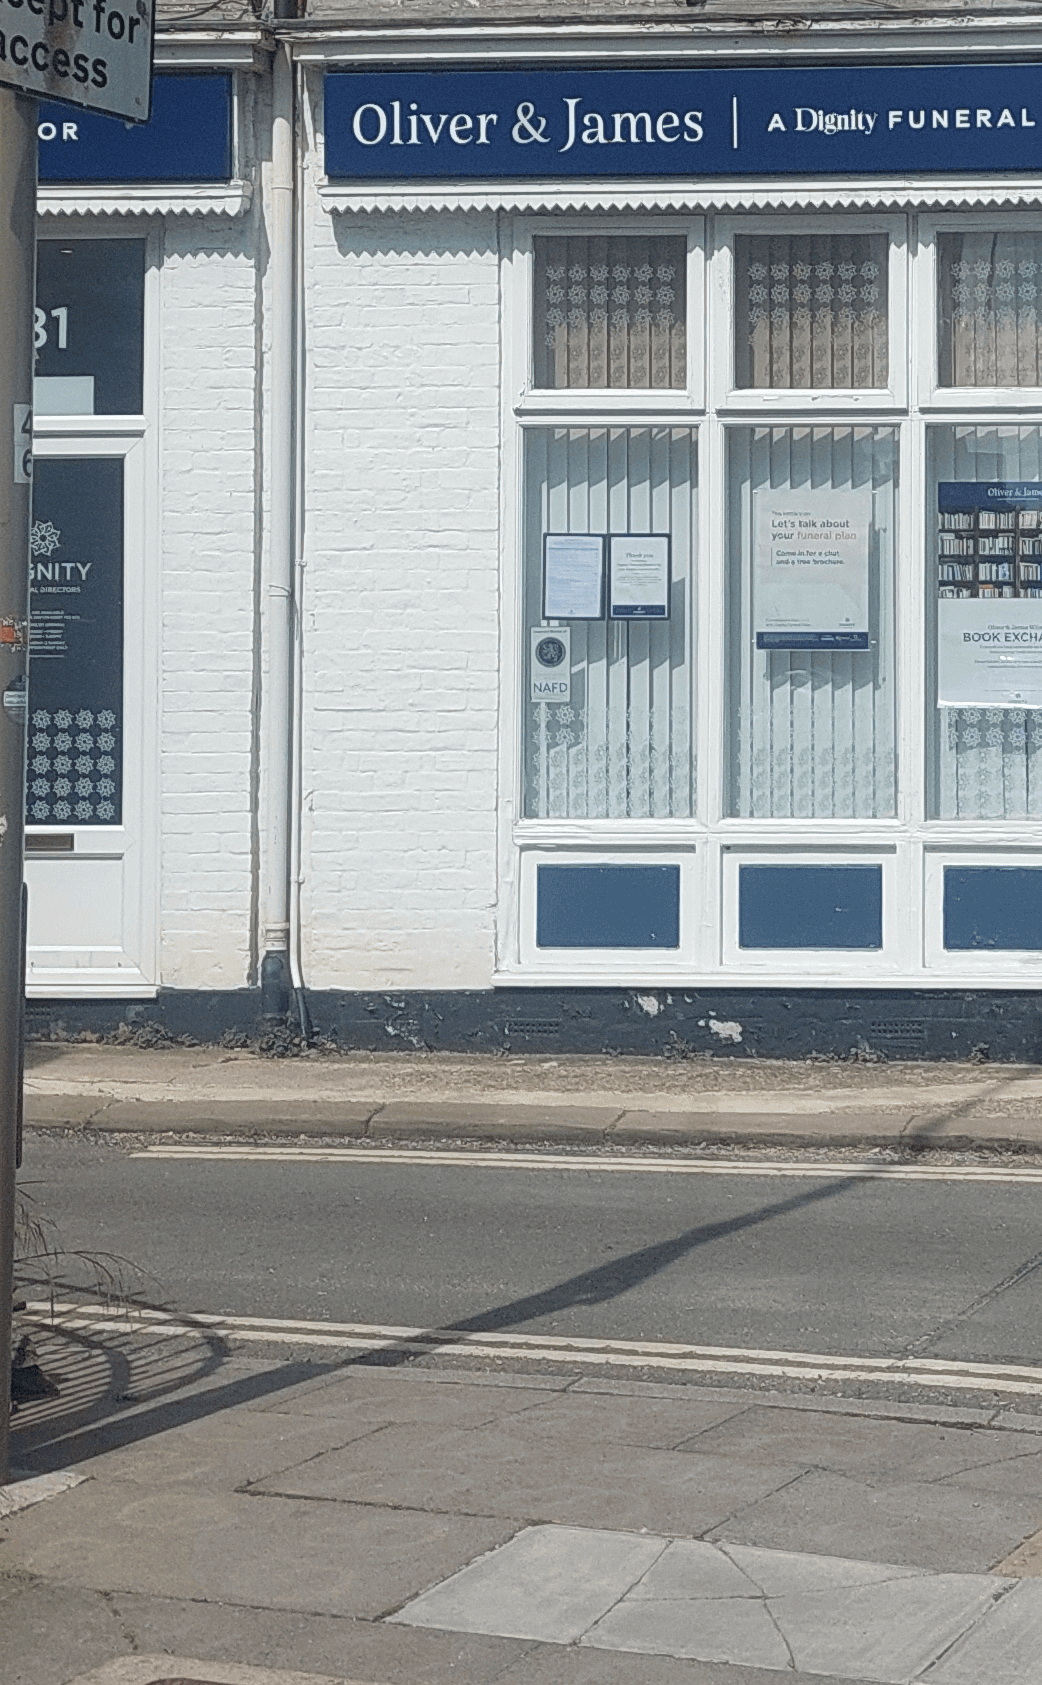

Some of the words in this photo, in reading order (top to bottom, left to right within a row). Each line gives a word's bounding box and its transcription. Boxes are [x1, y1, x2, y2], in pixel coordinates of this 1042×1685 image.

[352, 100, 498, 146] Oliver
[511, 100, 551, 145] &
[558, 97, 704, 153] James
[767, 113, 787, 132] A
[793, 107, 878, 136] Dignity
[888, 108, 1036, 131] FUNERAL
[987, 487, 1013, 497] Oliver
[772, 519, 796, 528] Let's
[798, 519, 817, 528] talk
[820, 519, 850, 528] about
[771, 532, 795, 541] your
[797, 530, 832, 540] funeral
[834, 530, 857, 541] plan
[963, 632, 1002, 643] BOOK
[533, 681, 569, 694] NAFD
